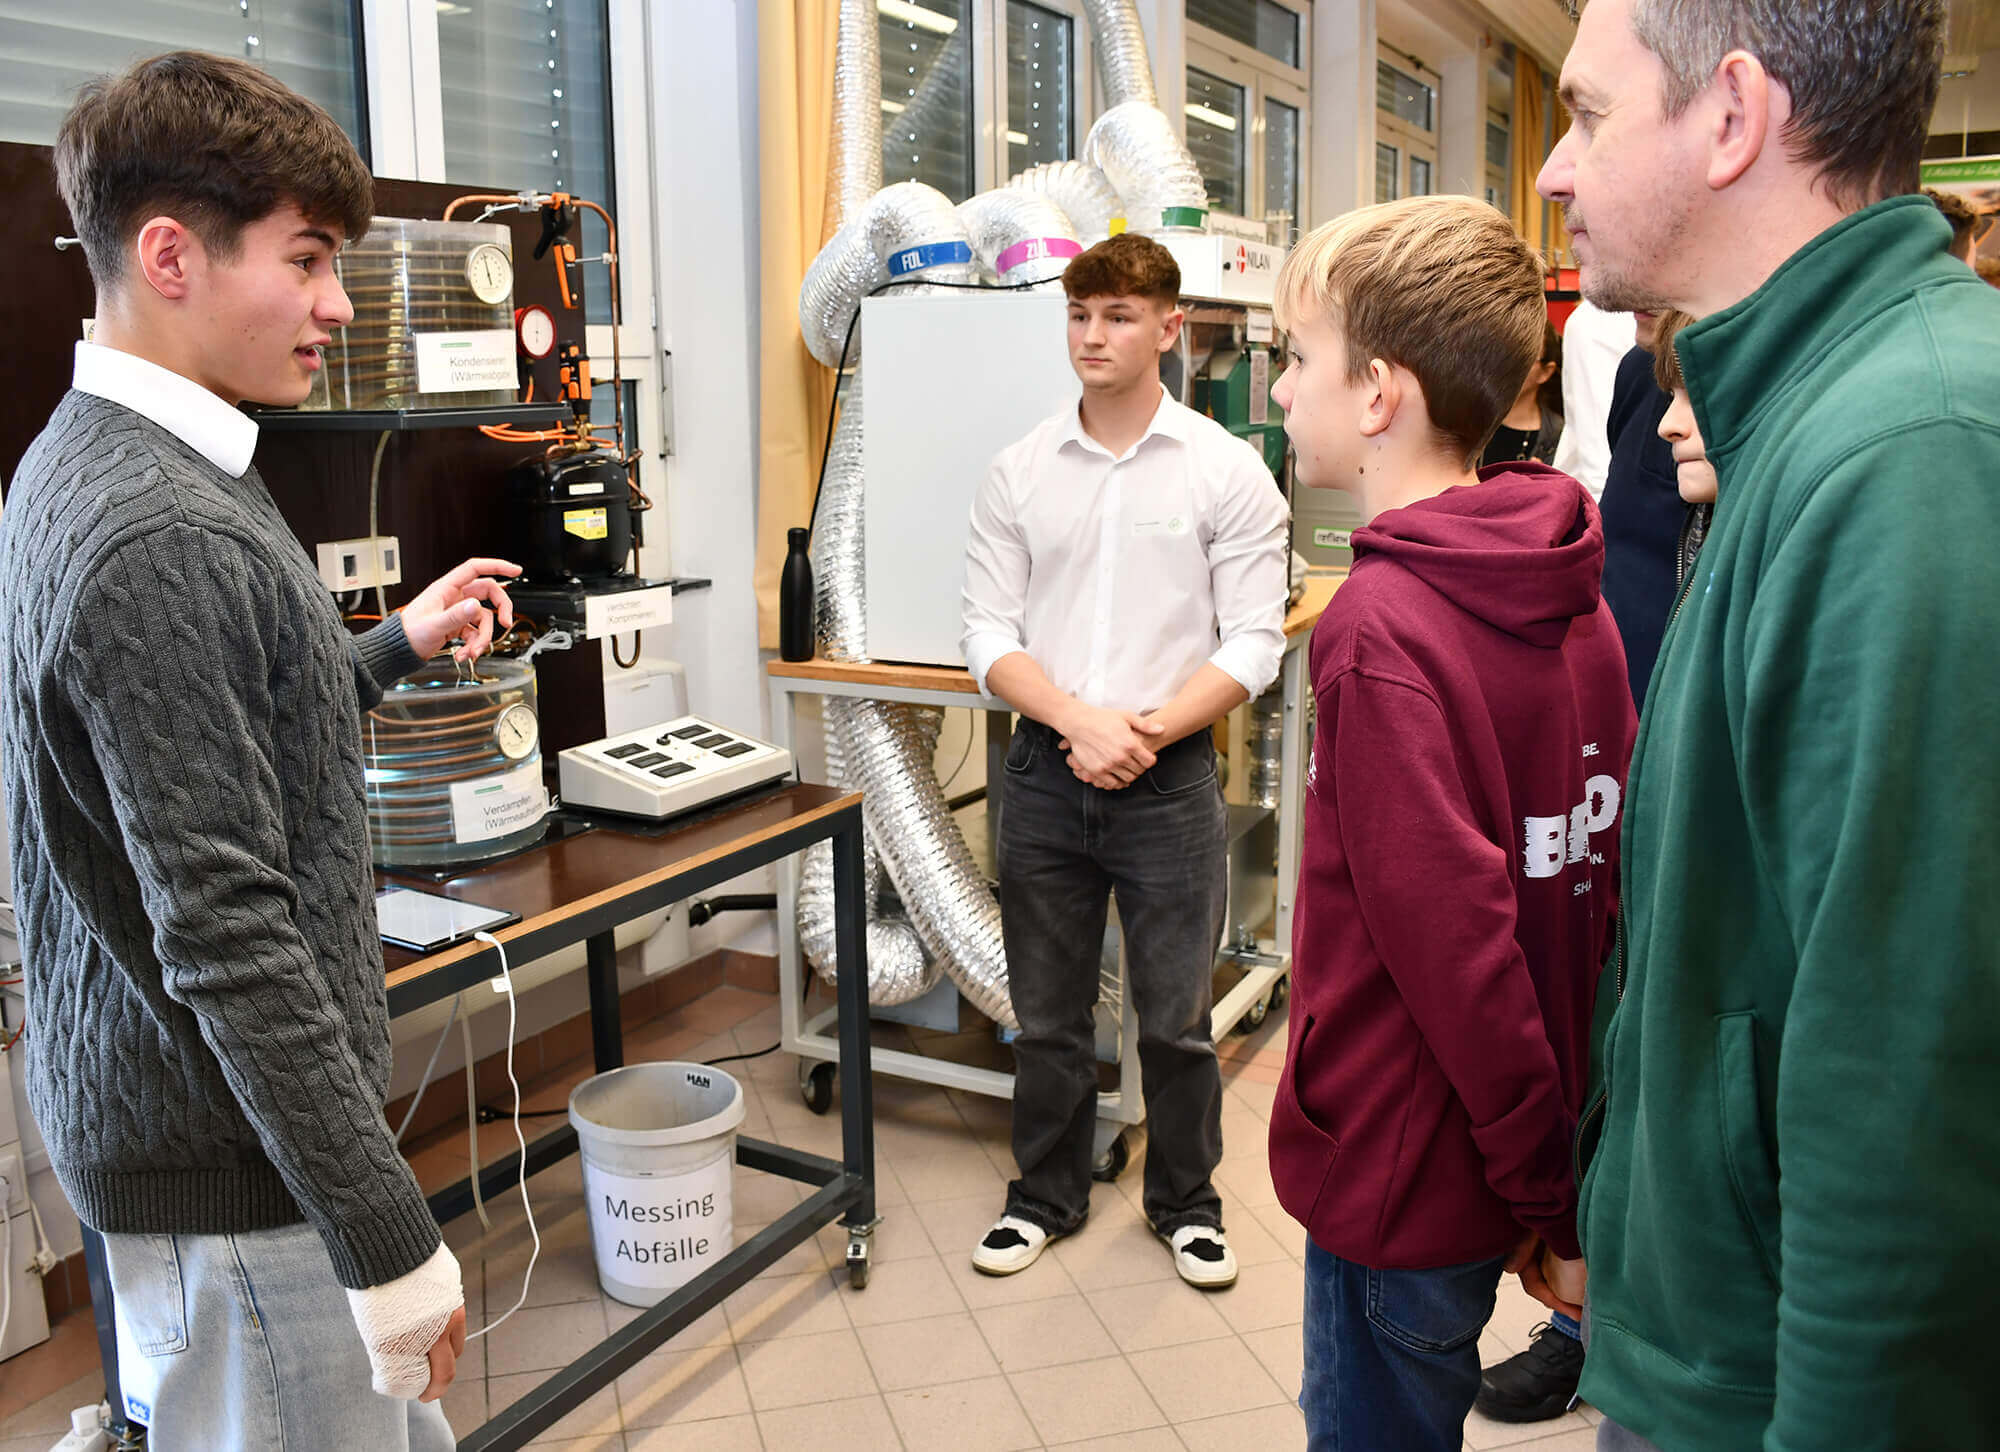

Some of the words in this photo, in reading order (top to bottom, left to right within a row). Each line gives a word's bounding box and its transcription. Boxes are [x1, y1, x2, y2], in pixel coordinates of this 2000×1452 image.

[1246, 249, 1272, 271] NILAN
[686, 1072, 711, 1089] HAN
[604, 1192, 715, 1224] Messing
[615, 1236, 710, 1265] Abfälle
